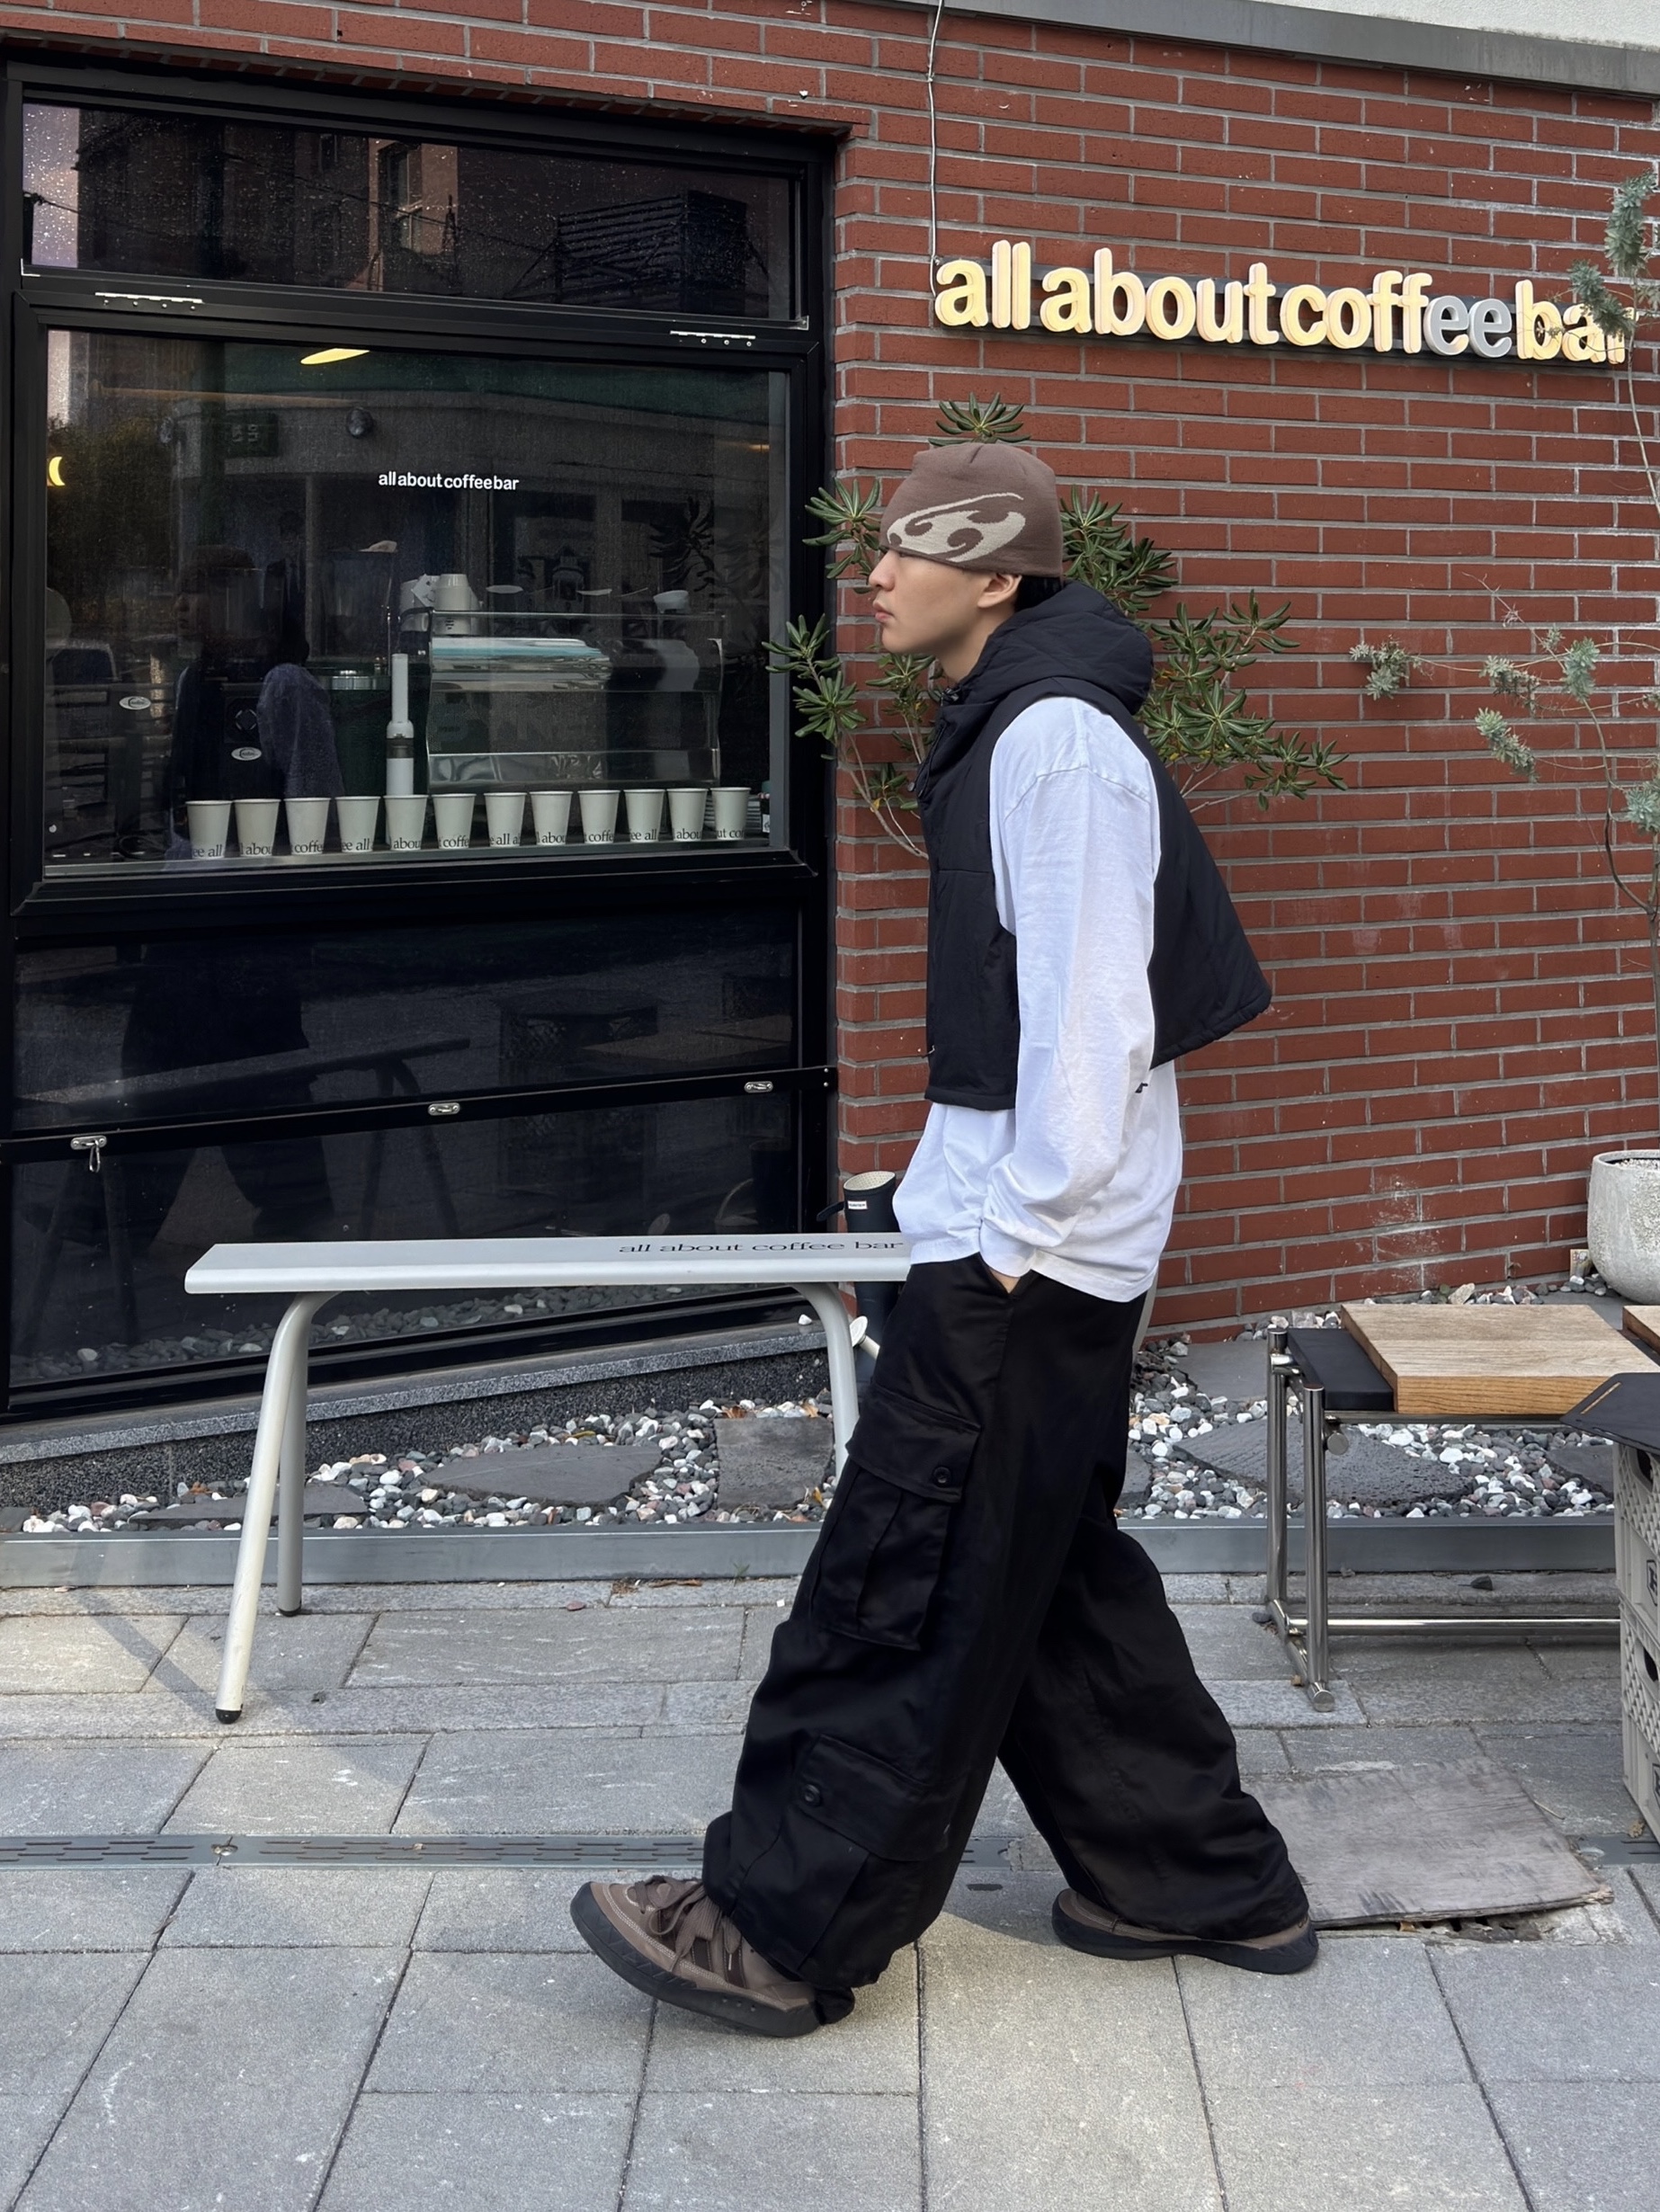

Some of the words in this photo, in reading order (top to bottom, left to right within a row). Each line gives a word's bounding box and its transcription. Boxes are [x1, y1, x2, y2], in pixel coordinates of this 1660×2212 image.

[495, 833, 511, 845] all
[644, 828, 657, 841] all
[208, 843, 223, 858] all
[355, 837, 370, 851] all
[619, 1244, 651, 1253] all
[659, 1243, 745, 1253] about
[752, 1241, 845, 1252] coffee
[854, 1241, 904, 1250] bar
